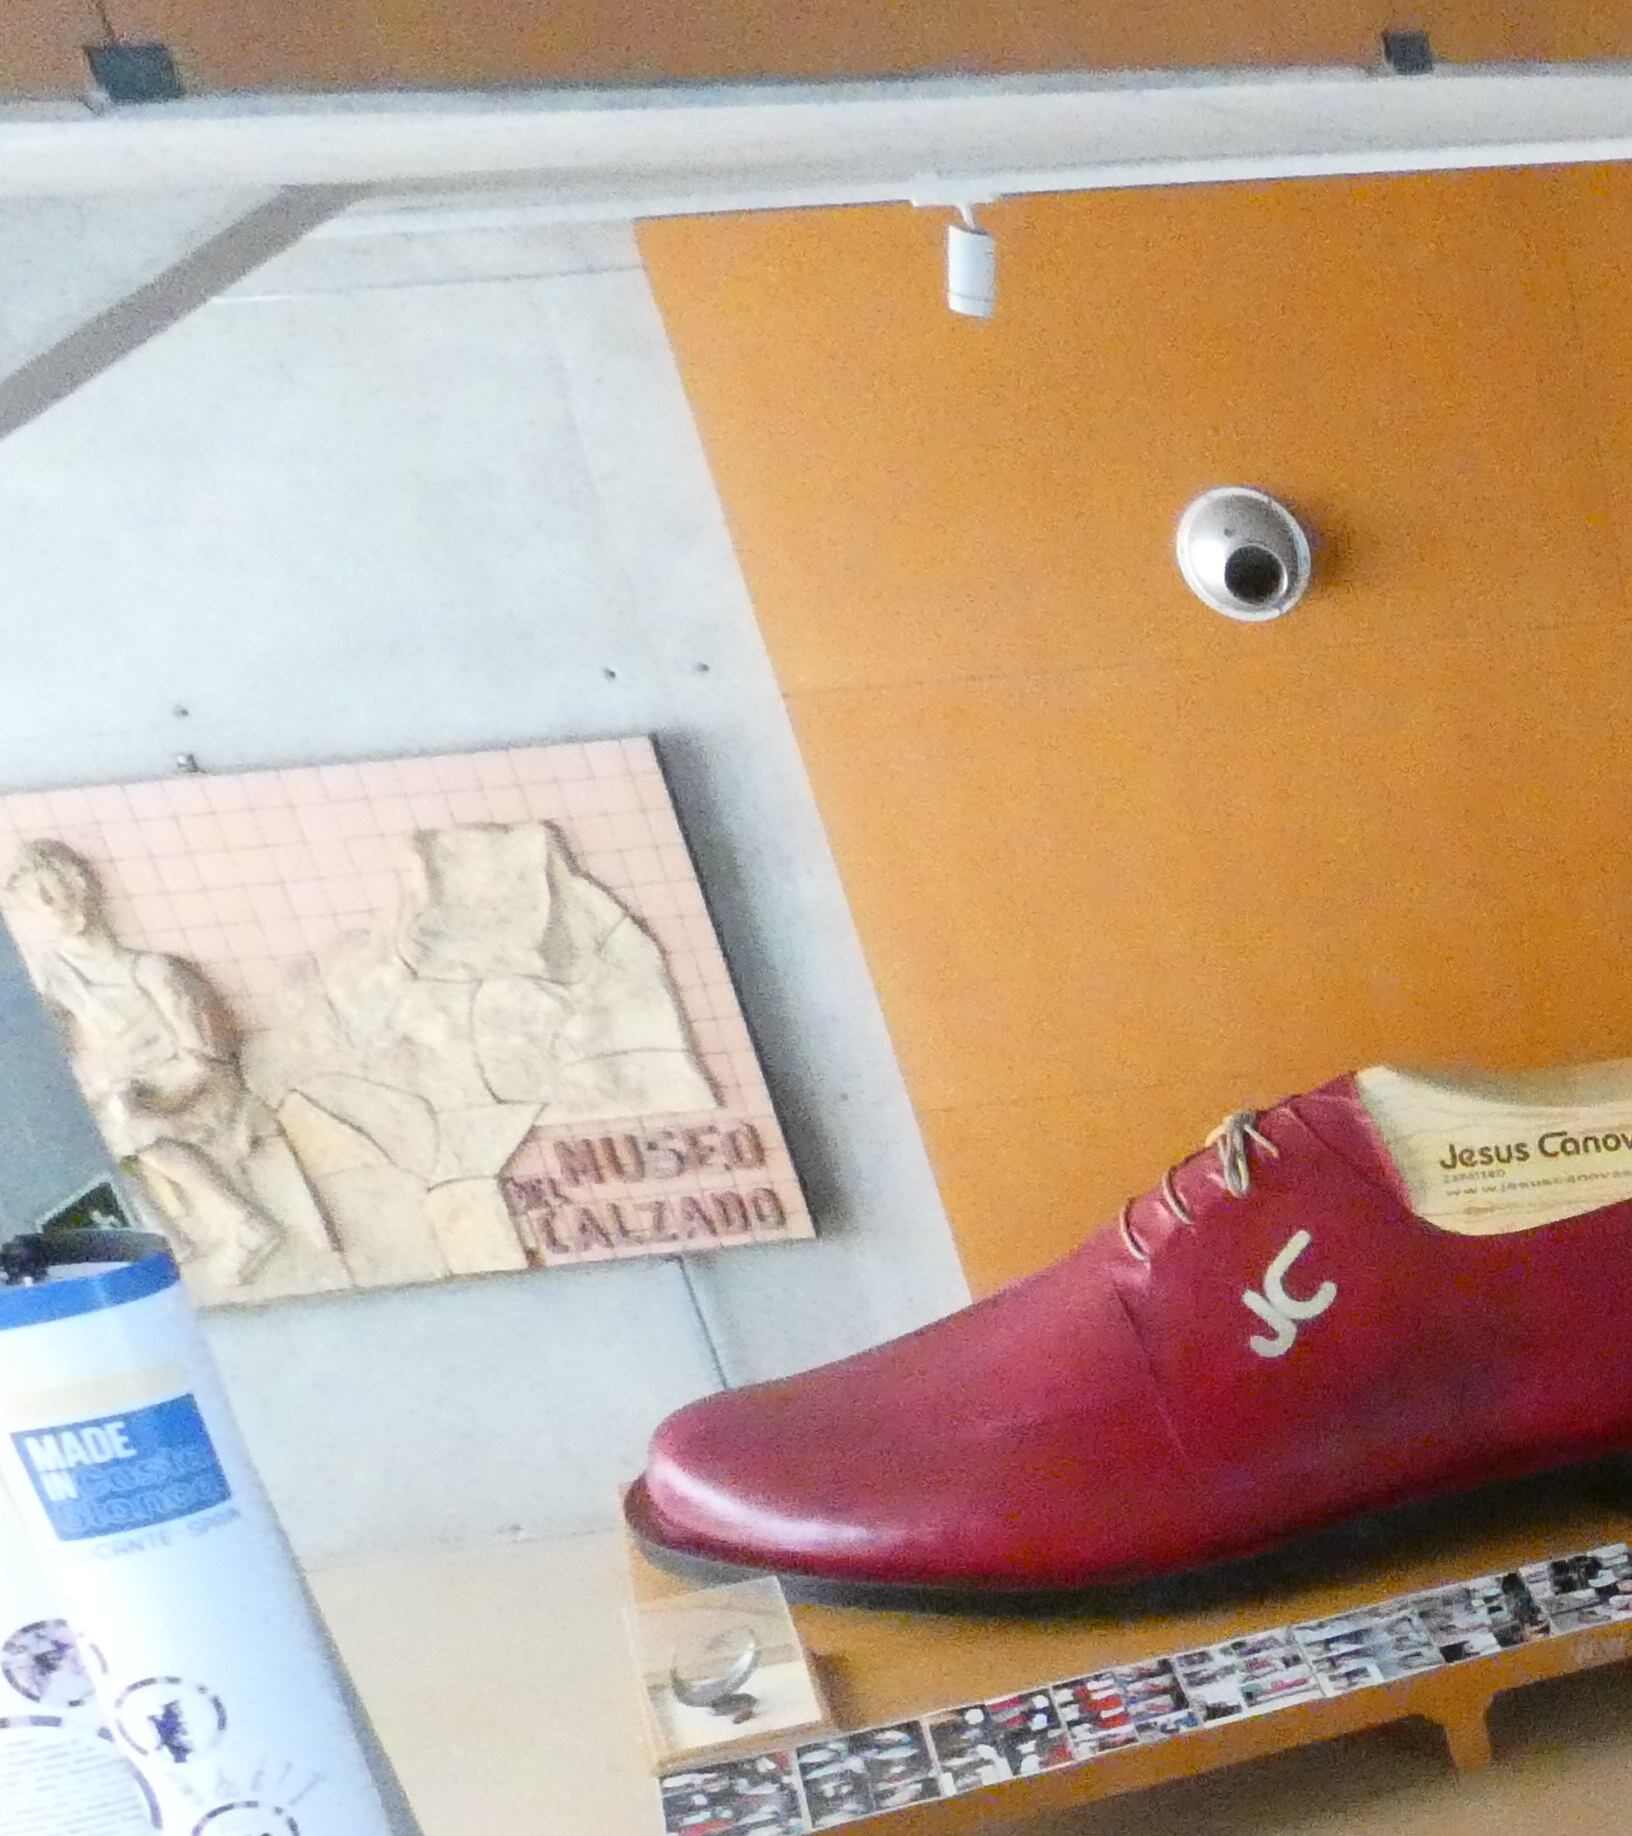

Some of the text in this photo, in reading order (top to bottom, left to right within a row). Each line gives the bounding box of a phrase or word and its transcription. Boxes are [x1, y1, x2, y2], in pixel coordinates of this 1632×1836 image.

[553, 1122, 766, 1186] MUSEO
[1439, 1141, 1531, 1171] Jesus
[537, 1186, 788, 1256] CALZADO
[23, 1420, 138, 1472] MADE
[40, 1468, 80, 1502] IN
